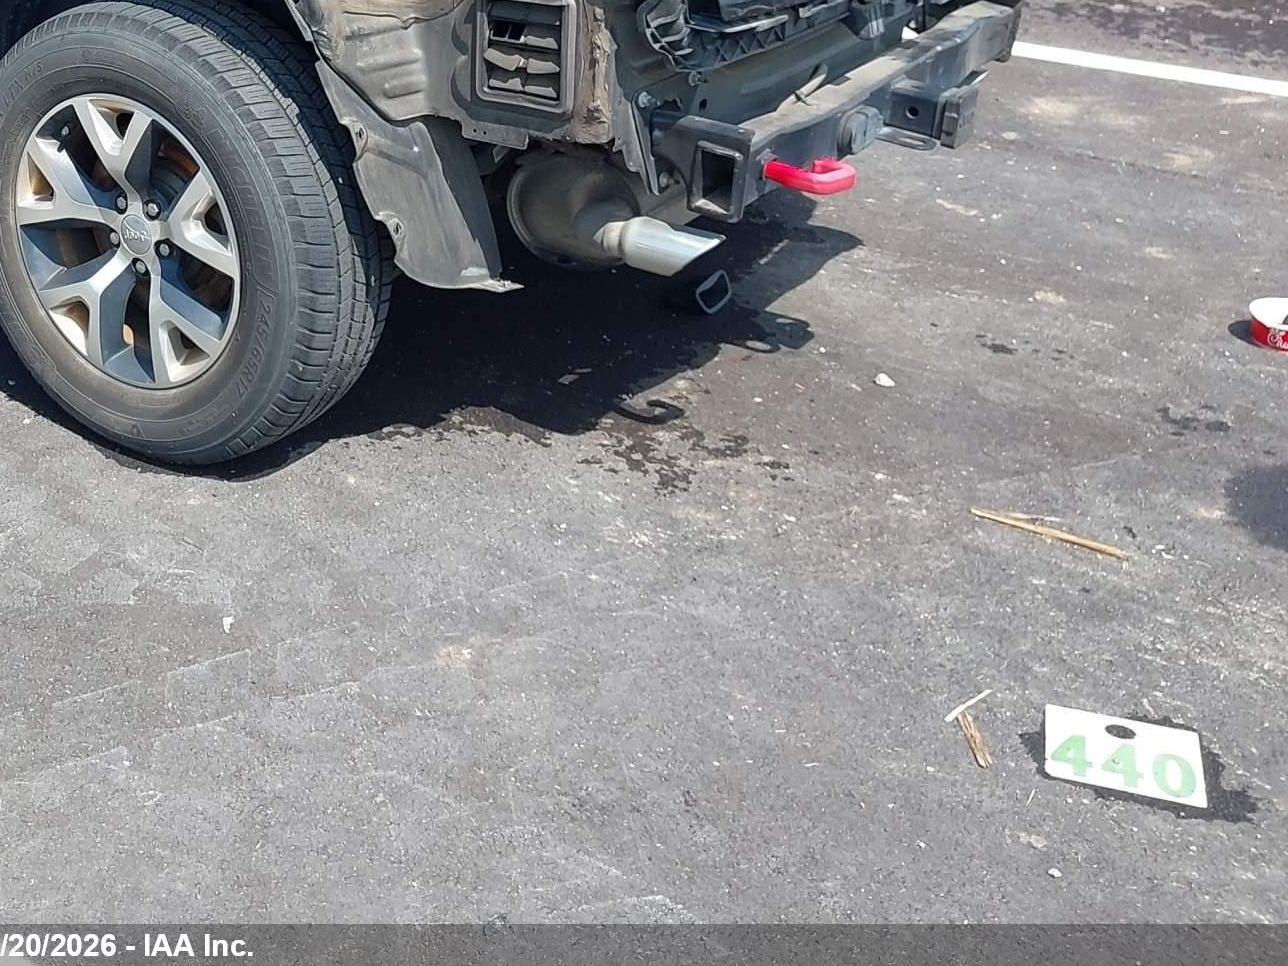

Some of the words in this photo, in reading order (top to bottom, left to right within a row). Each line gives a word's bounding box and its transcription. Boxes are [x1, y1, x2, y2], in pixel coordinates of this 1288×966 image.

[1, 76, 24, 109] LTX
[233, 298, 273, 400] 245/65R17
[1051, 733, 1197, 798] 440
